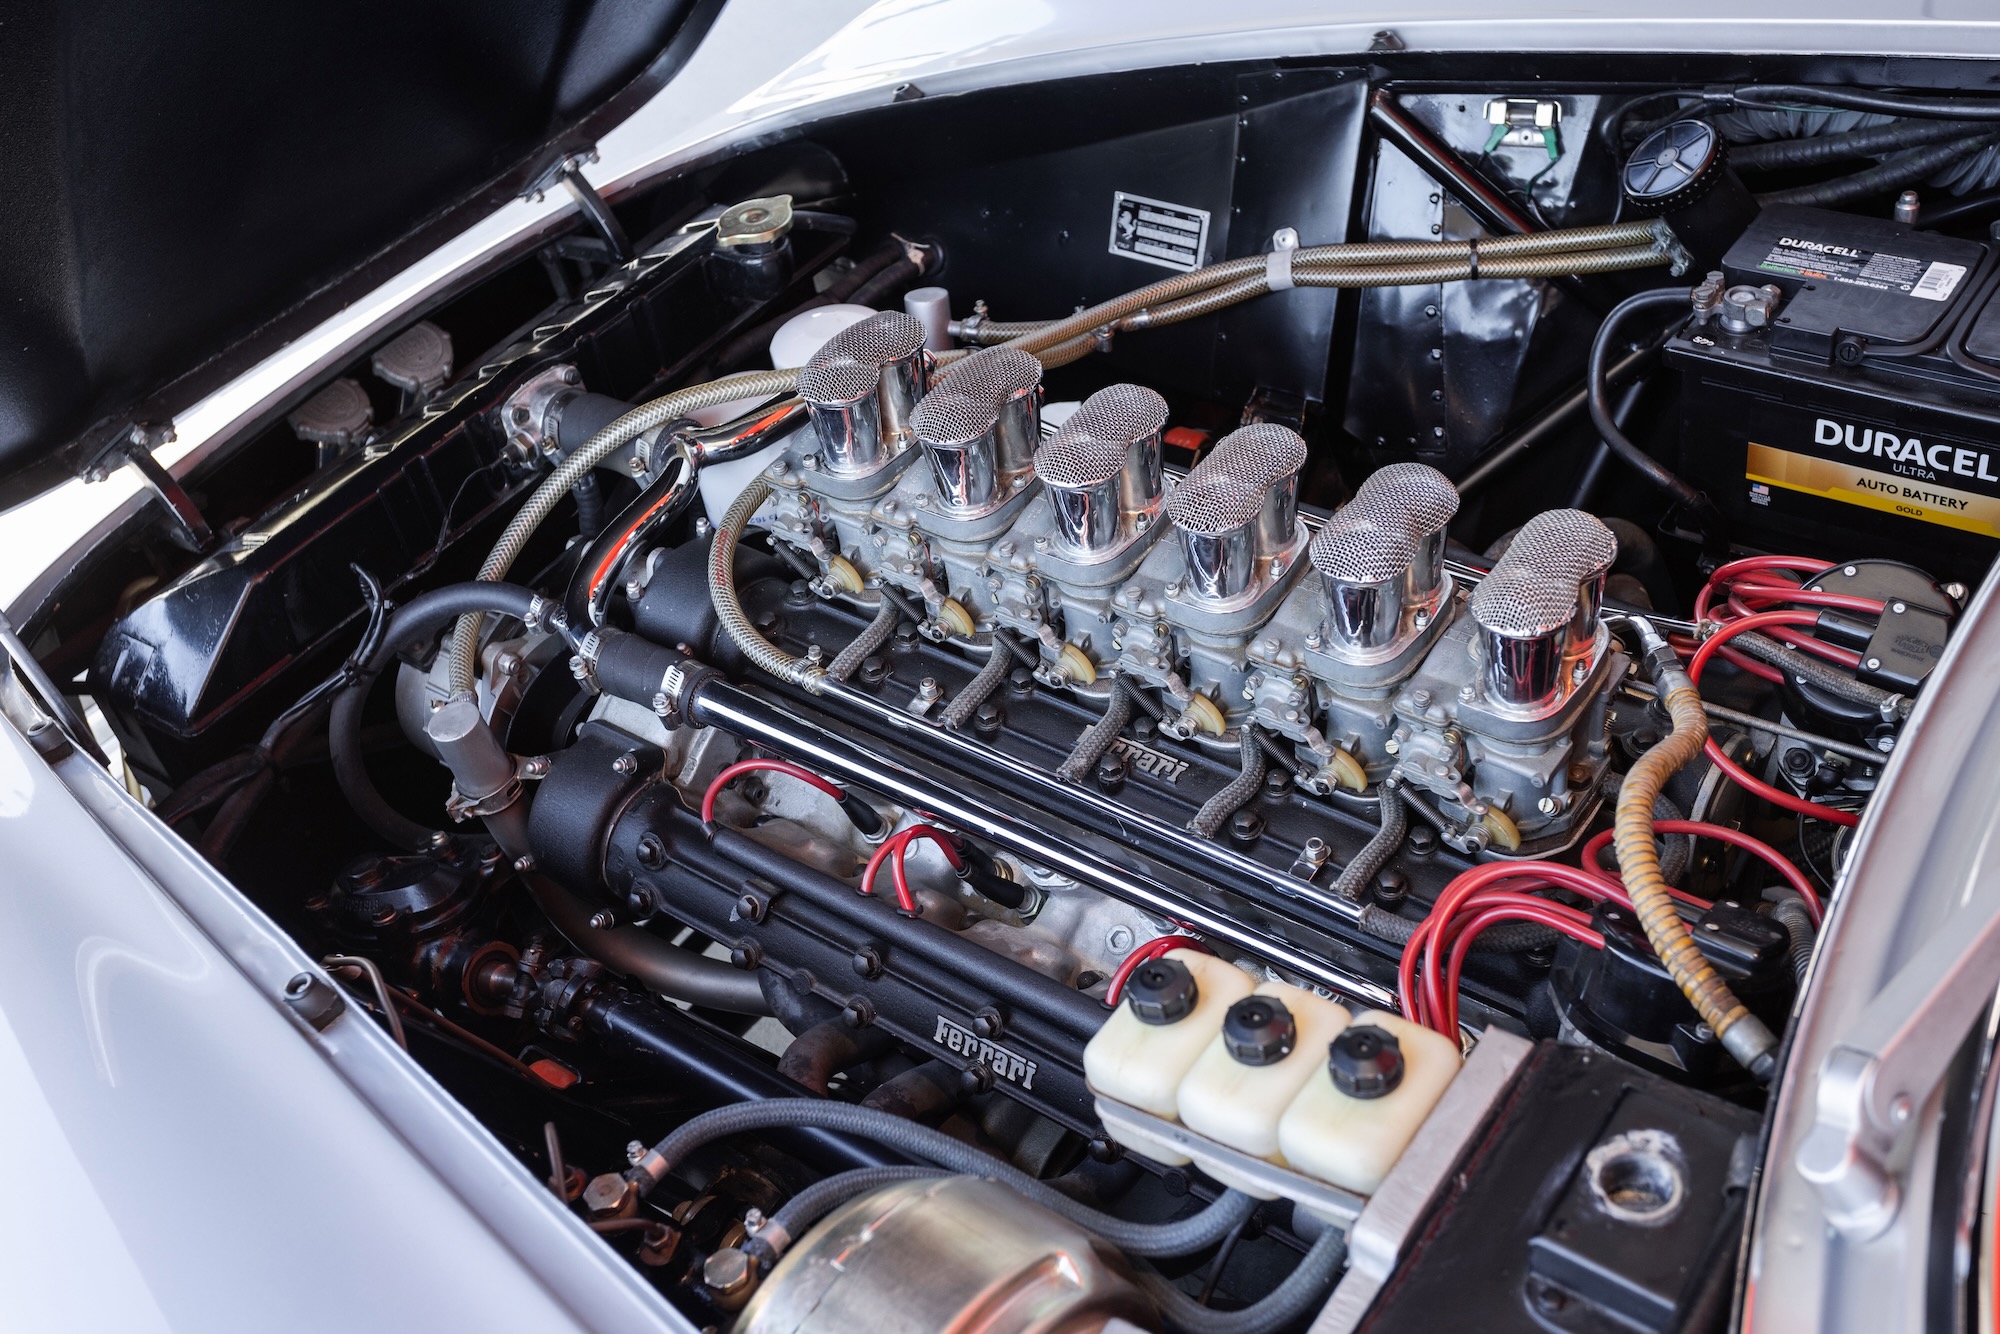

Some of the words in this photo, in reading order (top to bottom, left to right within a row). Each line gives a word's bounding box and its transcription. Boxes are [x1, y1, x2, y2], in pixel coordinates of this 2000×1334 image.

[1779, 237, 1858, 258] DURACELL
[1892, 463, 1936, 481] ULTRA
[1856, 477, 1899, 495] AUTO
[1902, 488, 1969, 511] BATTERY
[1895, 505, 1923, 516] GOLD
[933, 1014, 1038, 1090] Ferrari
